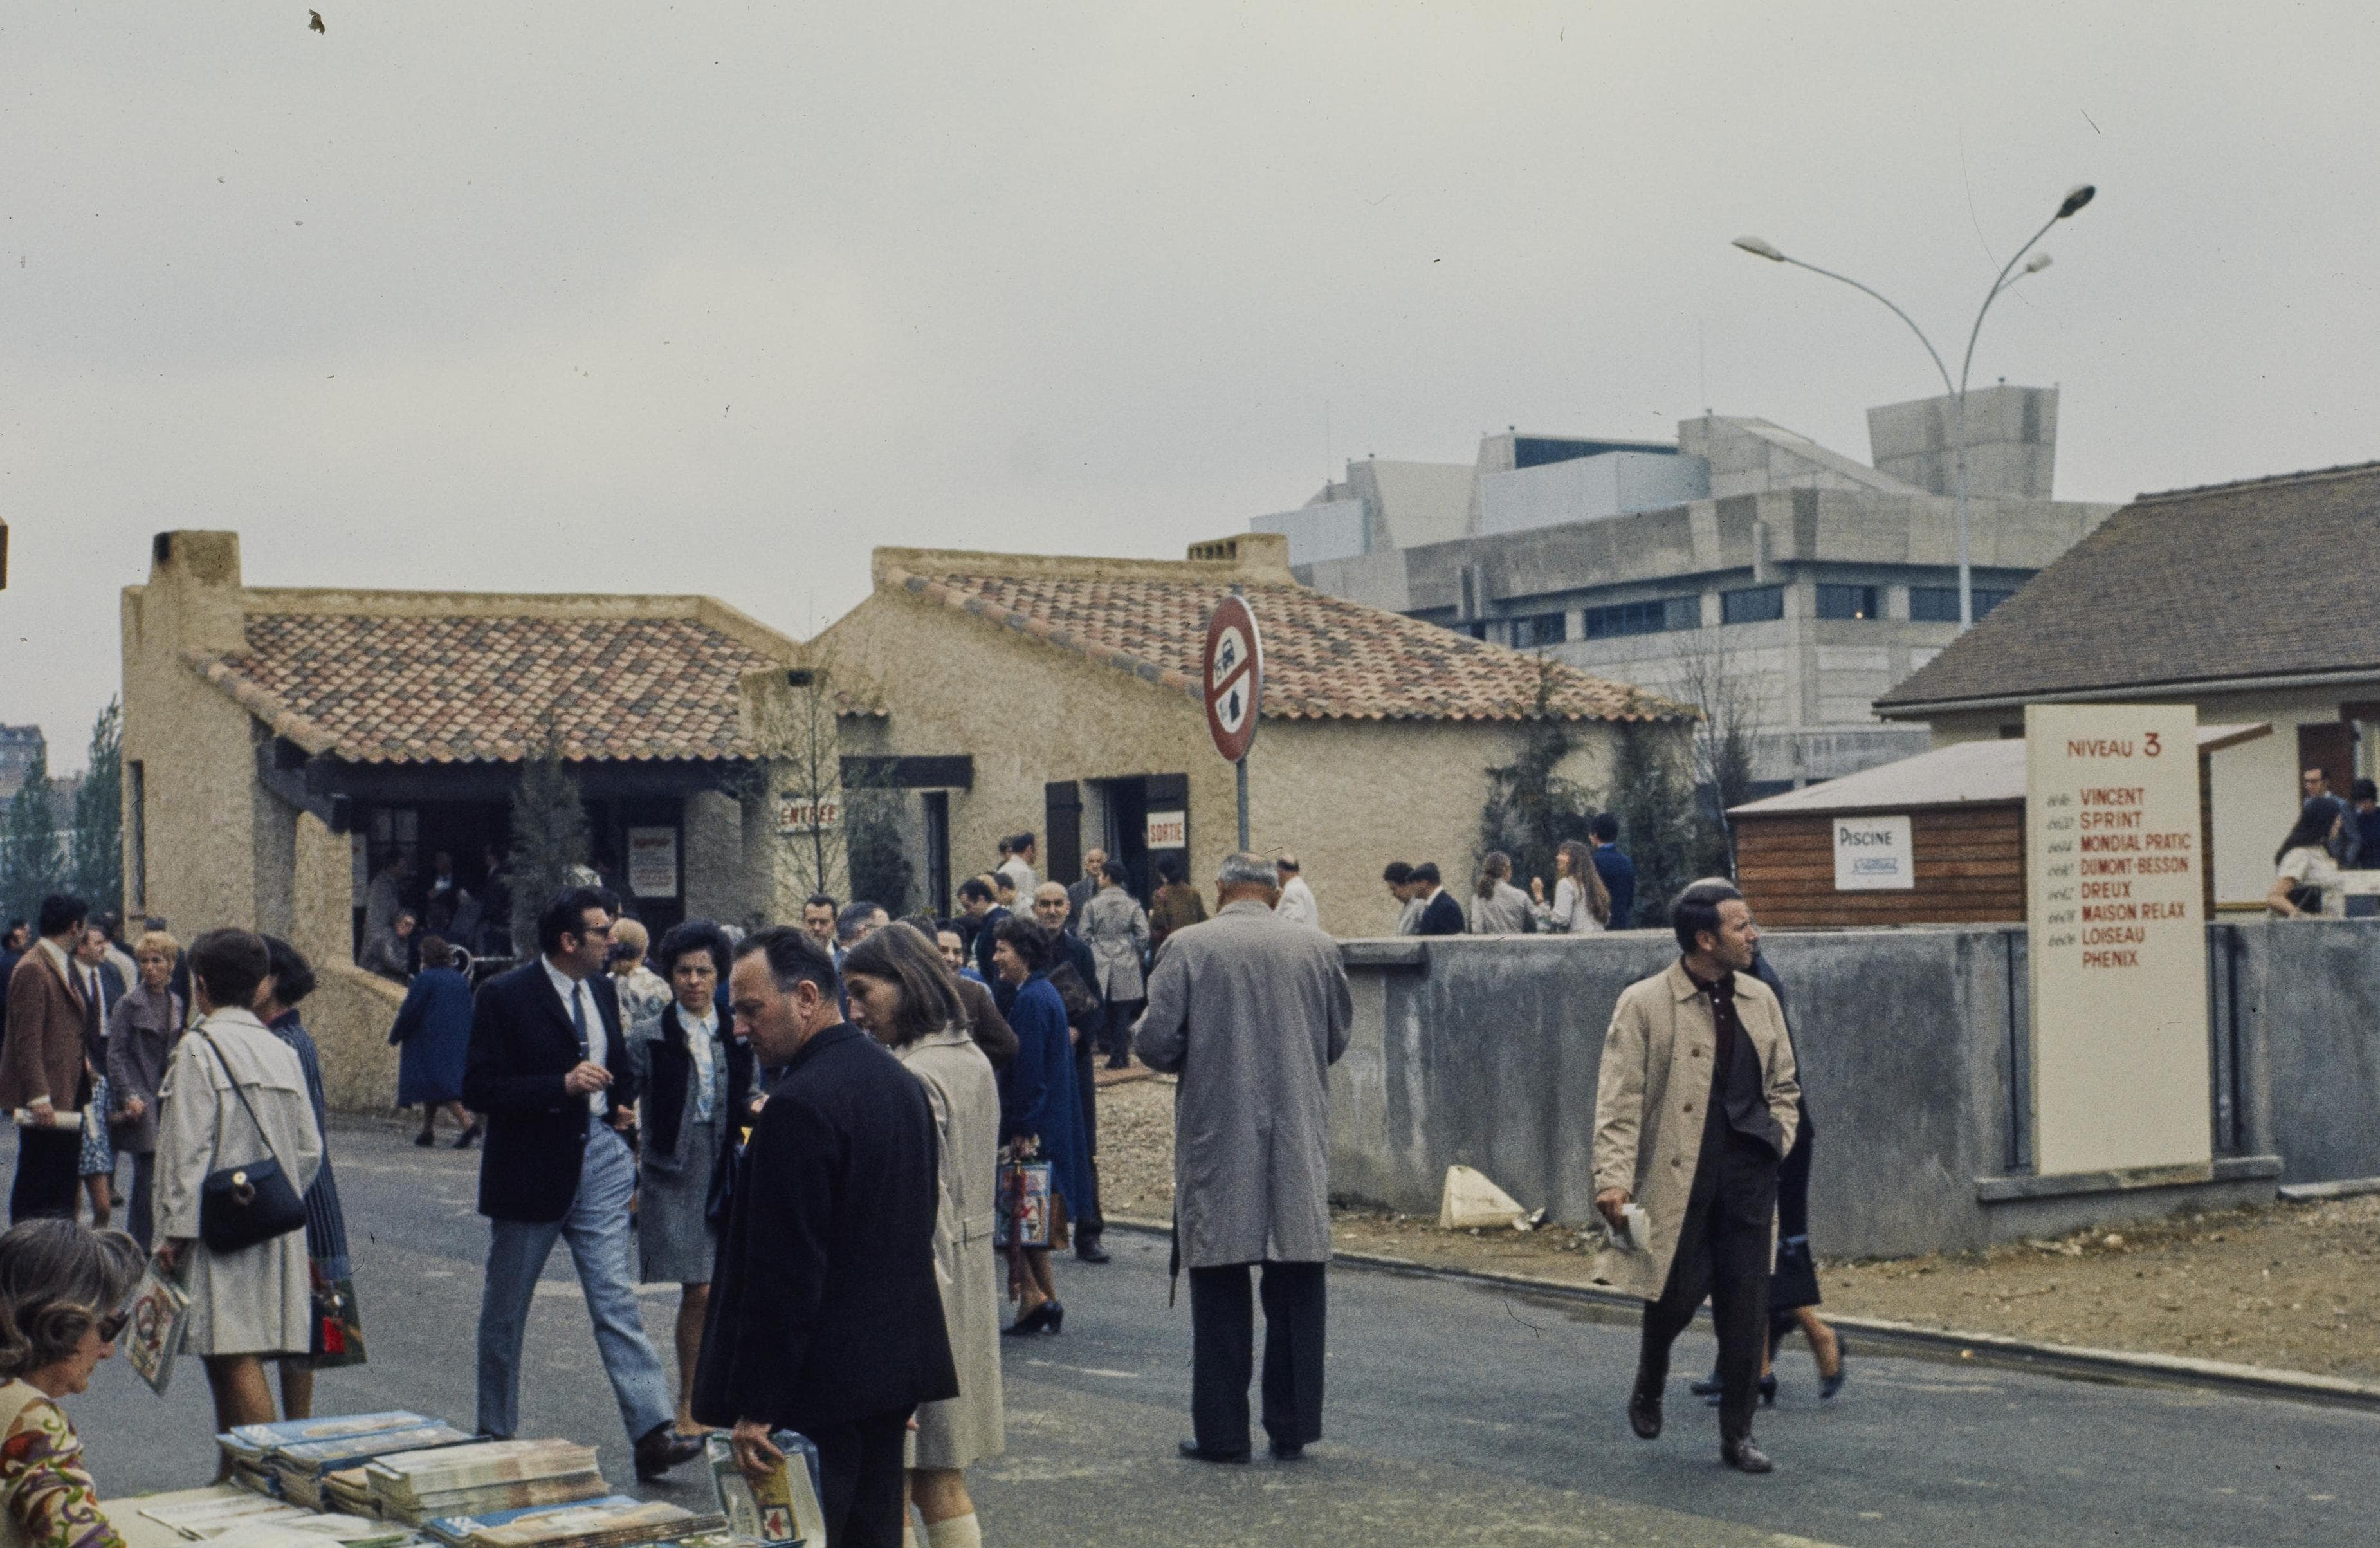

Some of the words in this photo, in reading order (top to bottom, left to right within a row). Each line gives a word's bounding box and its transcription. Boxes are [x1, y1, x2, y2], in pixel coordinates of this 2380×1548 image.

[2067, 739, 2134, 757] NIVEAU
[2144, 732, 2161, 757] 3
[2080, 788, 2145, 806] VINCENT
[2080, 811, 2142, 829] SPRINT
[1150, 823, 1182, 842] SORTIE
[1840, 827, 1892, 847] PISCINE
[2080, 835, 2141, 852] MONDIAL
[2145, 833, 2191, 850] PRATIC
[2082, 881, 2132, 899] DREUX
[2082, 903, 2136, 921] MAISON
[2141, 902, 2185, 919] RELAX
[2082, 926, 2146, 946] LOISEAU
[2082, 949, 2139, 968] PHENIX
